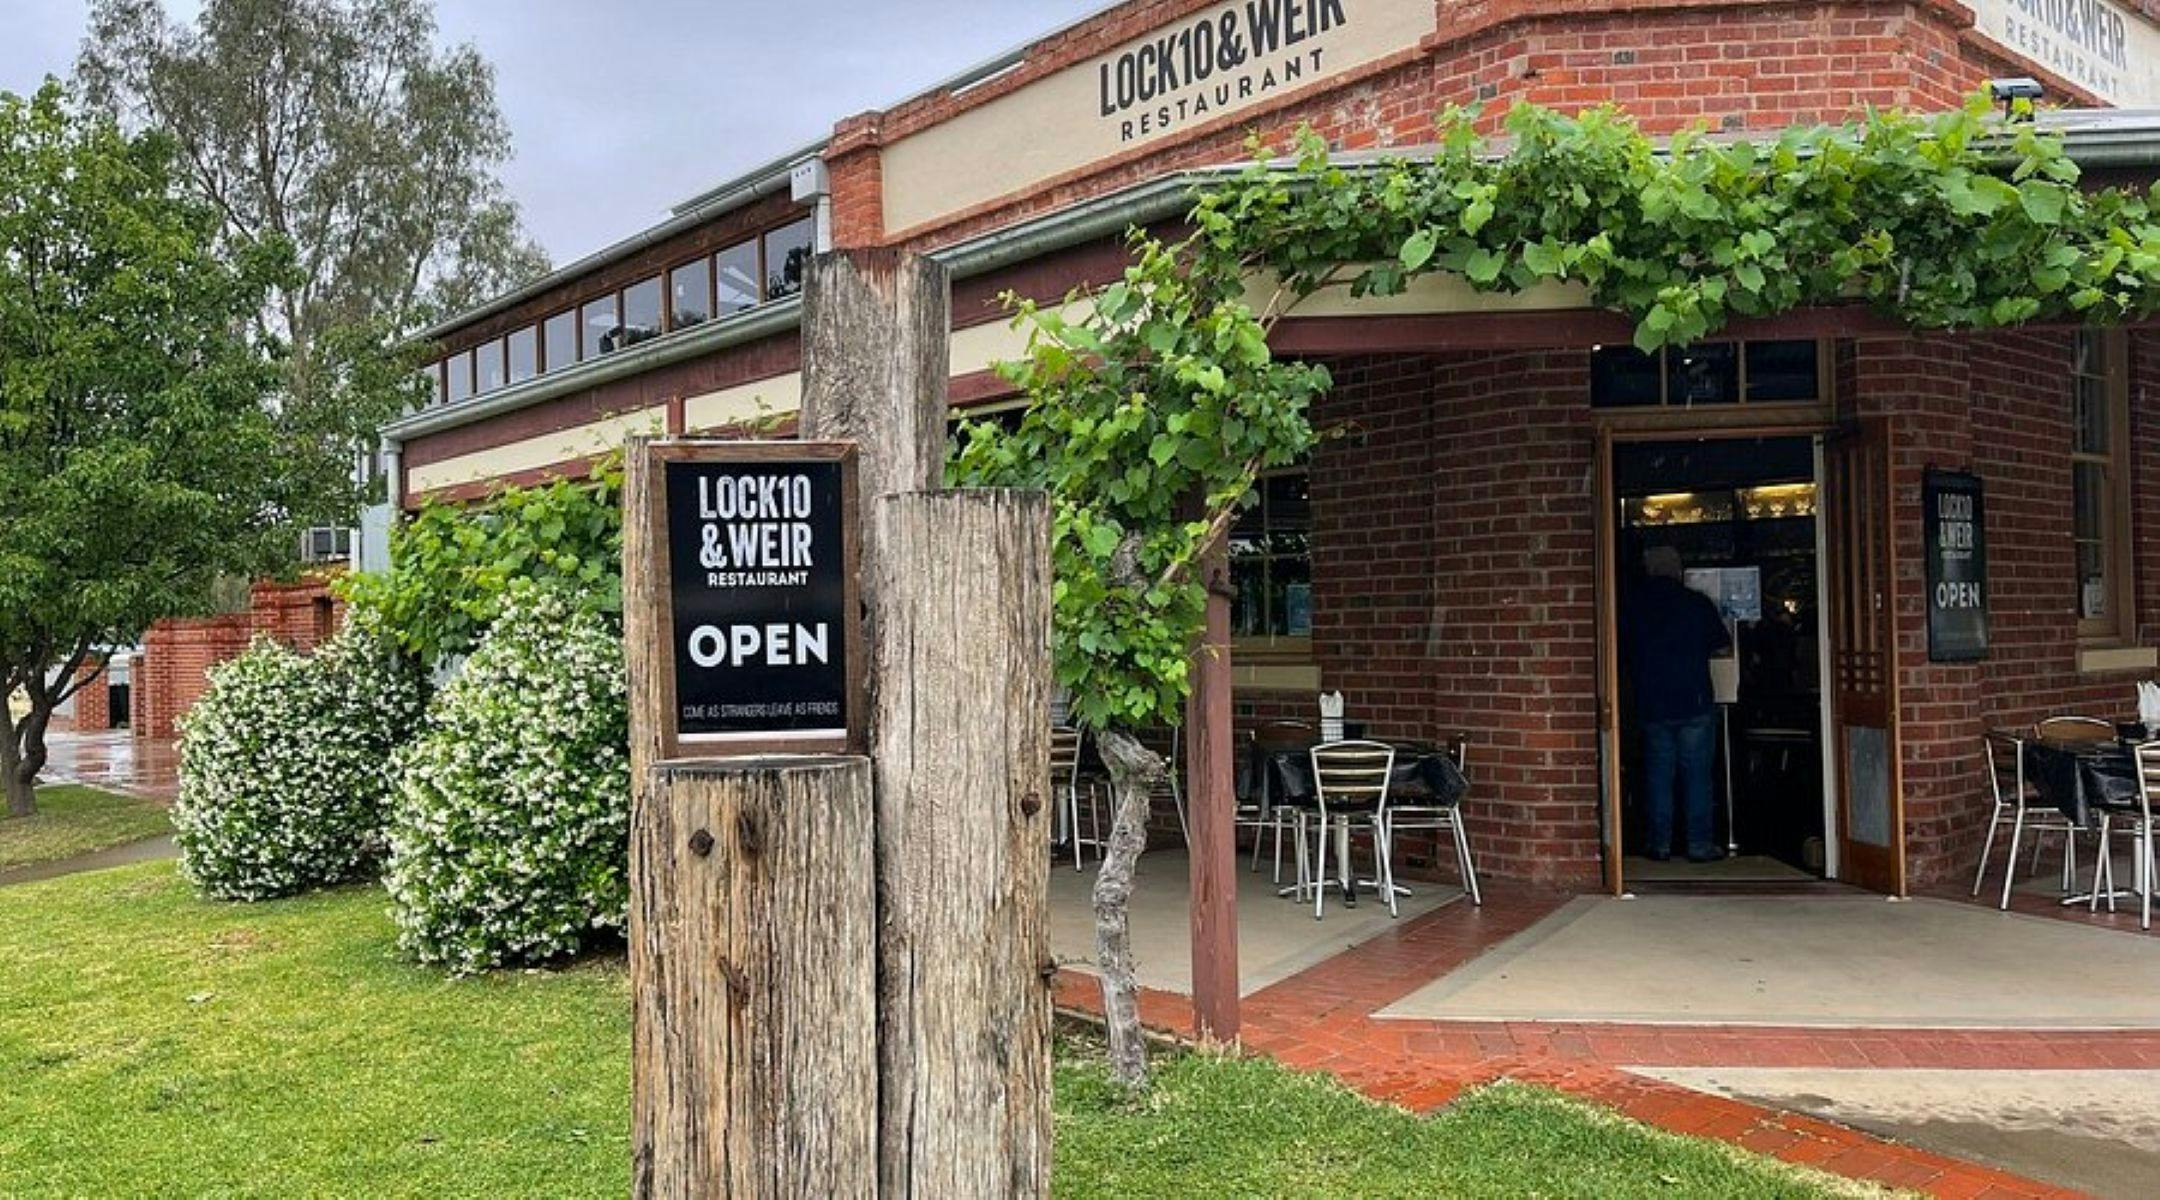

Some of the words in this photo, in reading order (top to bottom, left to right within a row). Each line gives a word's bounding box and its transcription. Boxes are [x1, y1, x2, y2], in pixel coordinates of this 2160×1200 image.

[2004, 14, 2118, 98] RESTAURANT
[1120, 48, 1324, 141] RESTAURANT
[698, 474, 812, 520] LOCK10
[707, 571, 809, 587] RESTAURANT
[1935, 581, 1981, 608] OPEN
[688, 622, 829, 668] OPEN
